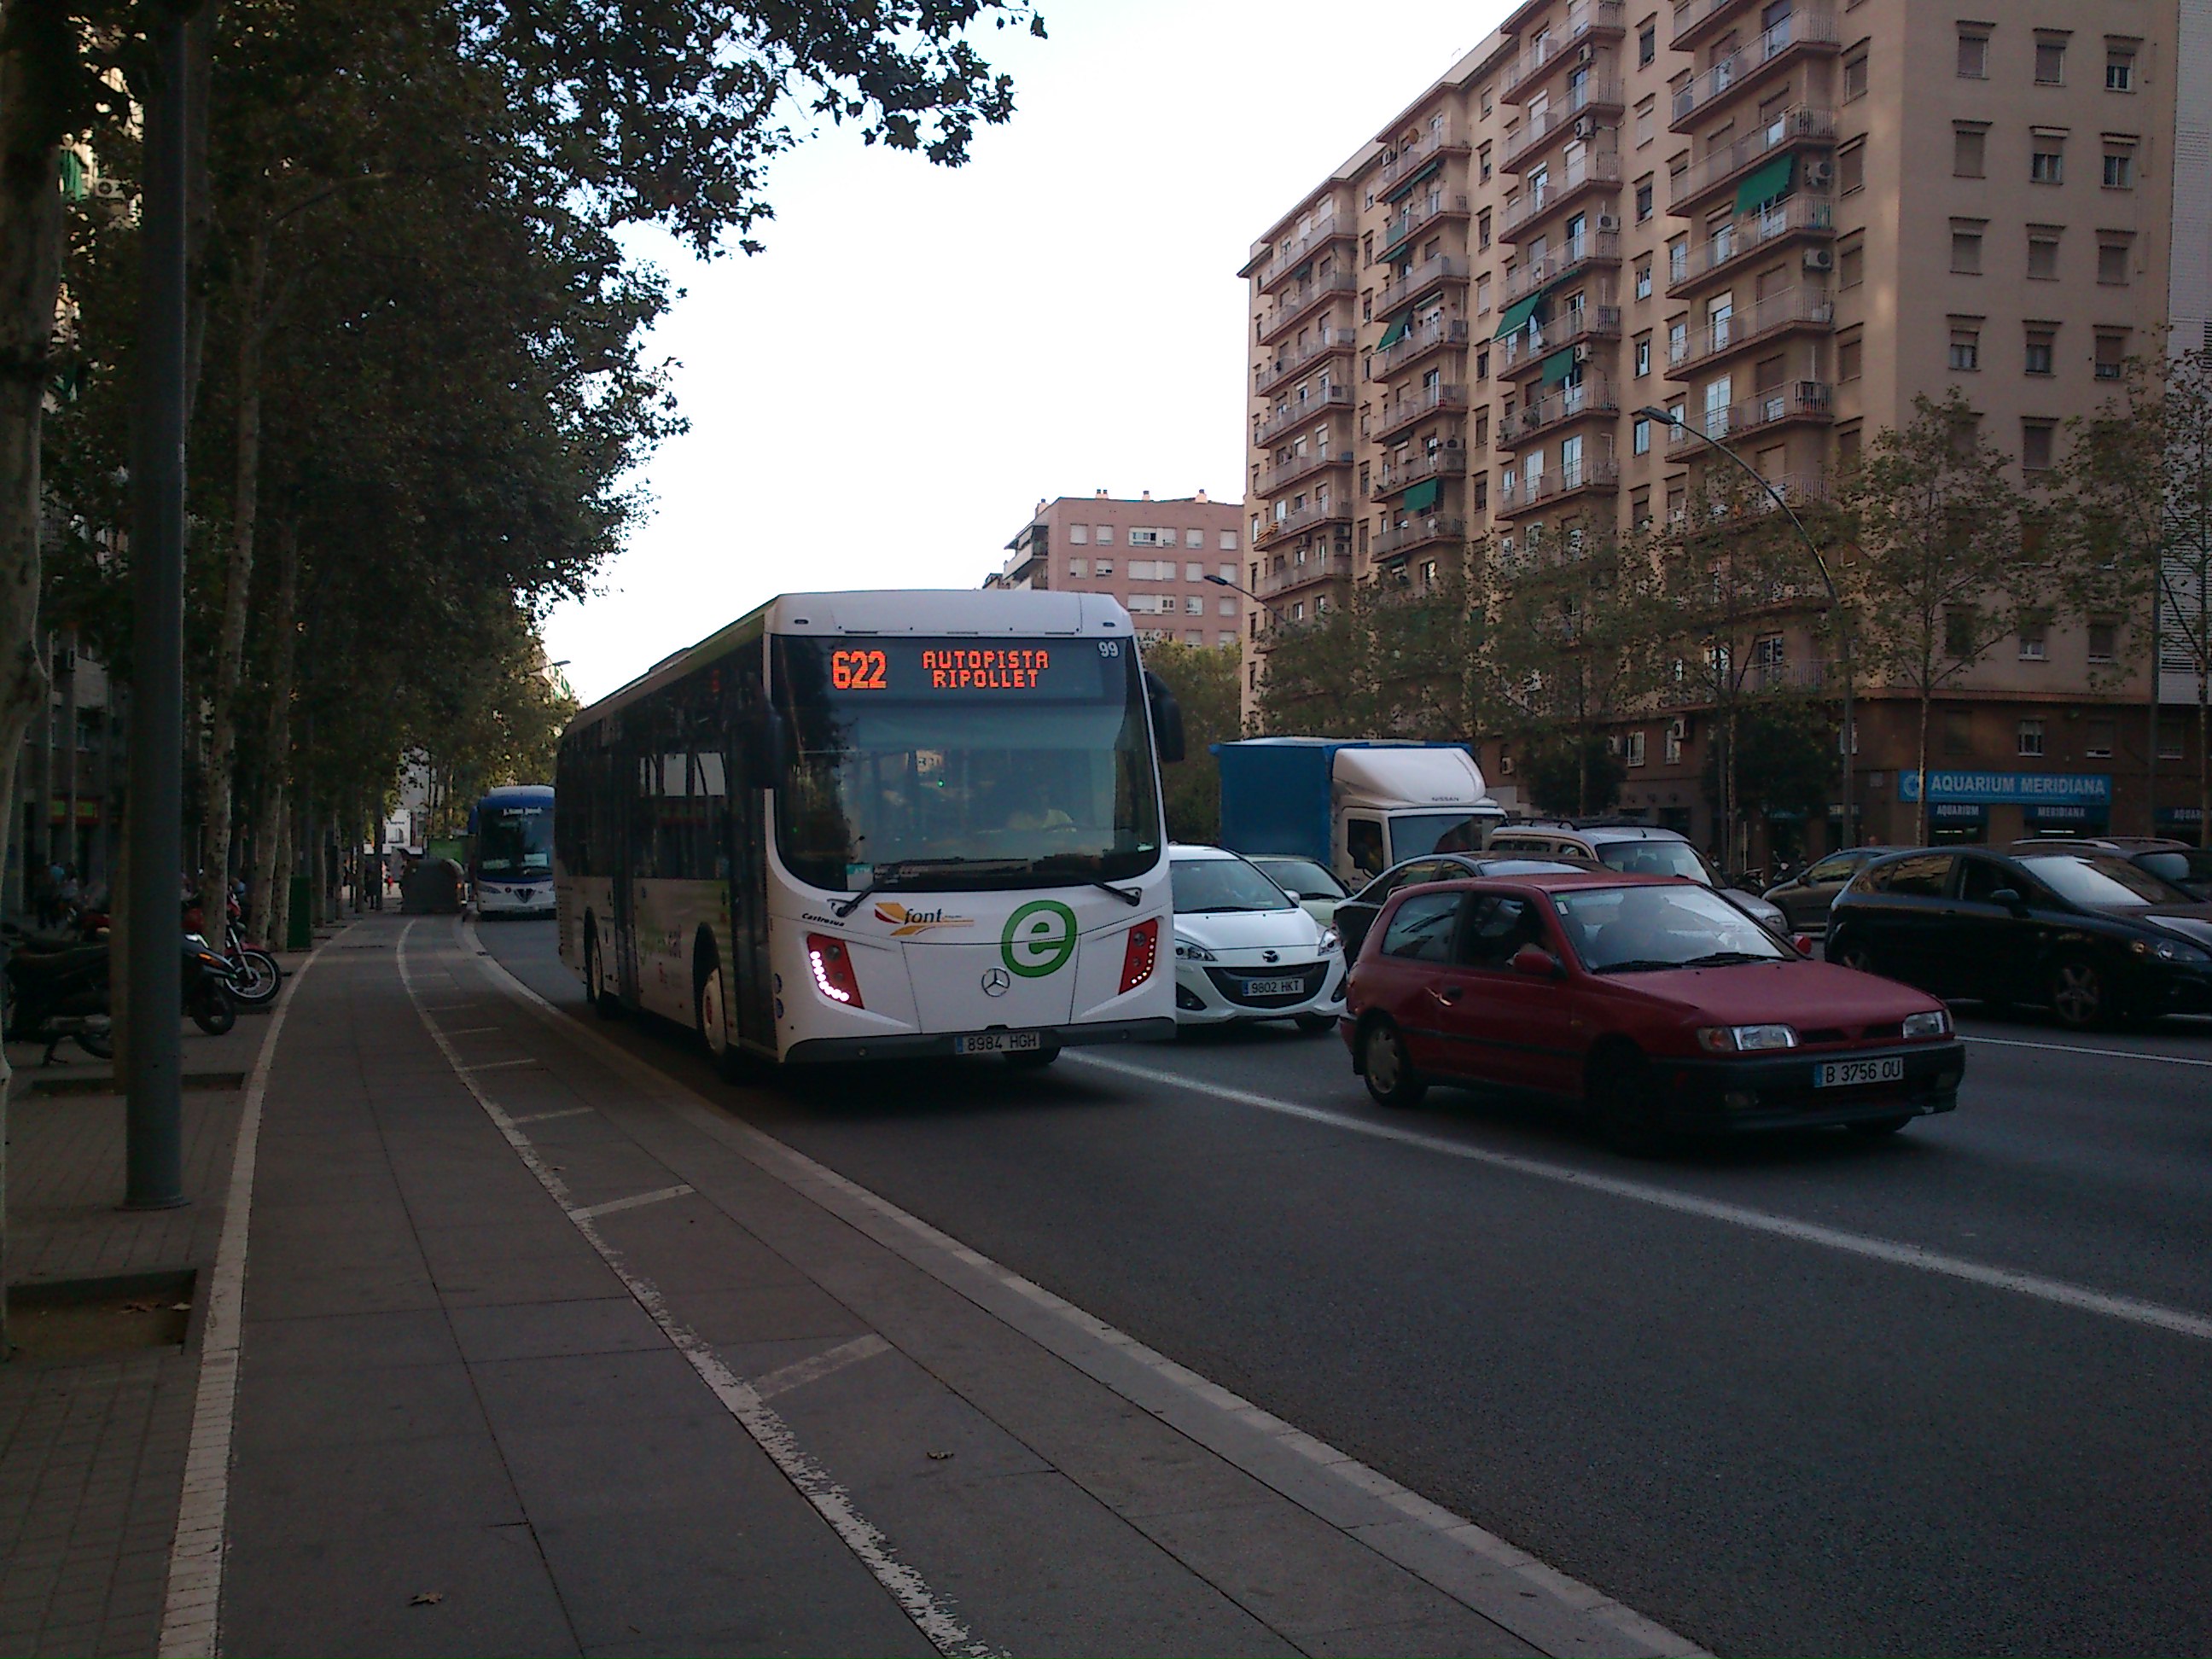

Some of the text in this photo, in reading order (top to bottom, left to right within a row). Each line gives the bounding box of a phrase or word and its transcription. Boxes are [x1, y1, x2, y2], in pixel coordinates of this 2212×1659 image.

[1098, 641, 1119, 658] 99
[923, 650, 1049, 669] AUTOPISTA
[832, 650, 887, 689] 622
[933, 669, 1039, 688] RIPOLLET
[1931, 775, 2105, 795] AQUARIUM MERIDIANA
[1936, 805, 1979, 817] AQUARIUM
[2037, 806, 2085, 818] MERIDIANA
[801, 912, 845, 927] Castrosua
[905, 908, 942, 925] font
[1251, 980, 1299, 993] 9802 HKT
[968, 1033, 1036, 1051] 8984 HGH
[1826, 1060, 1901, 1083] B 3756 OU
